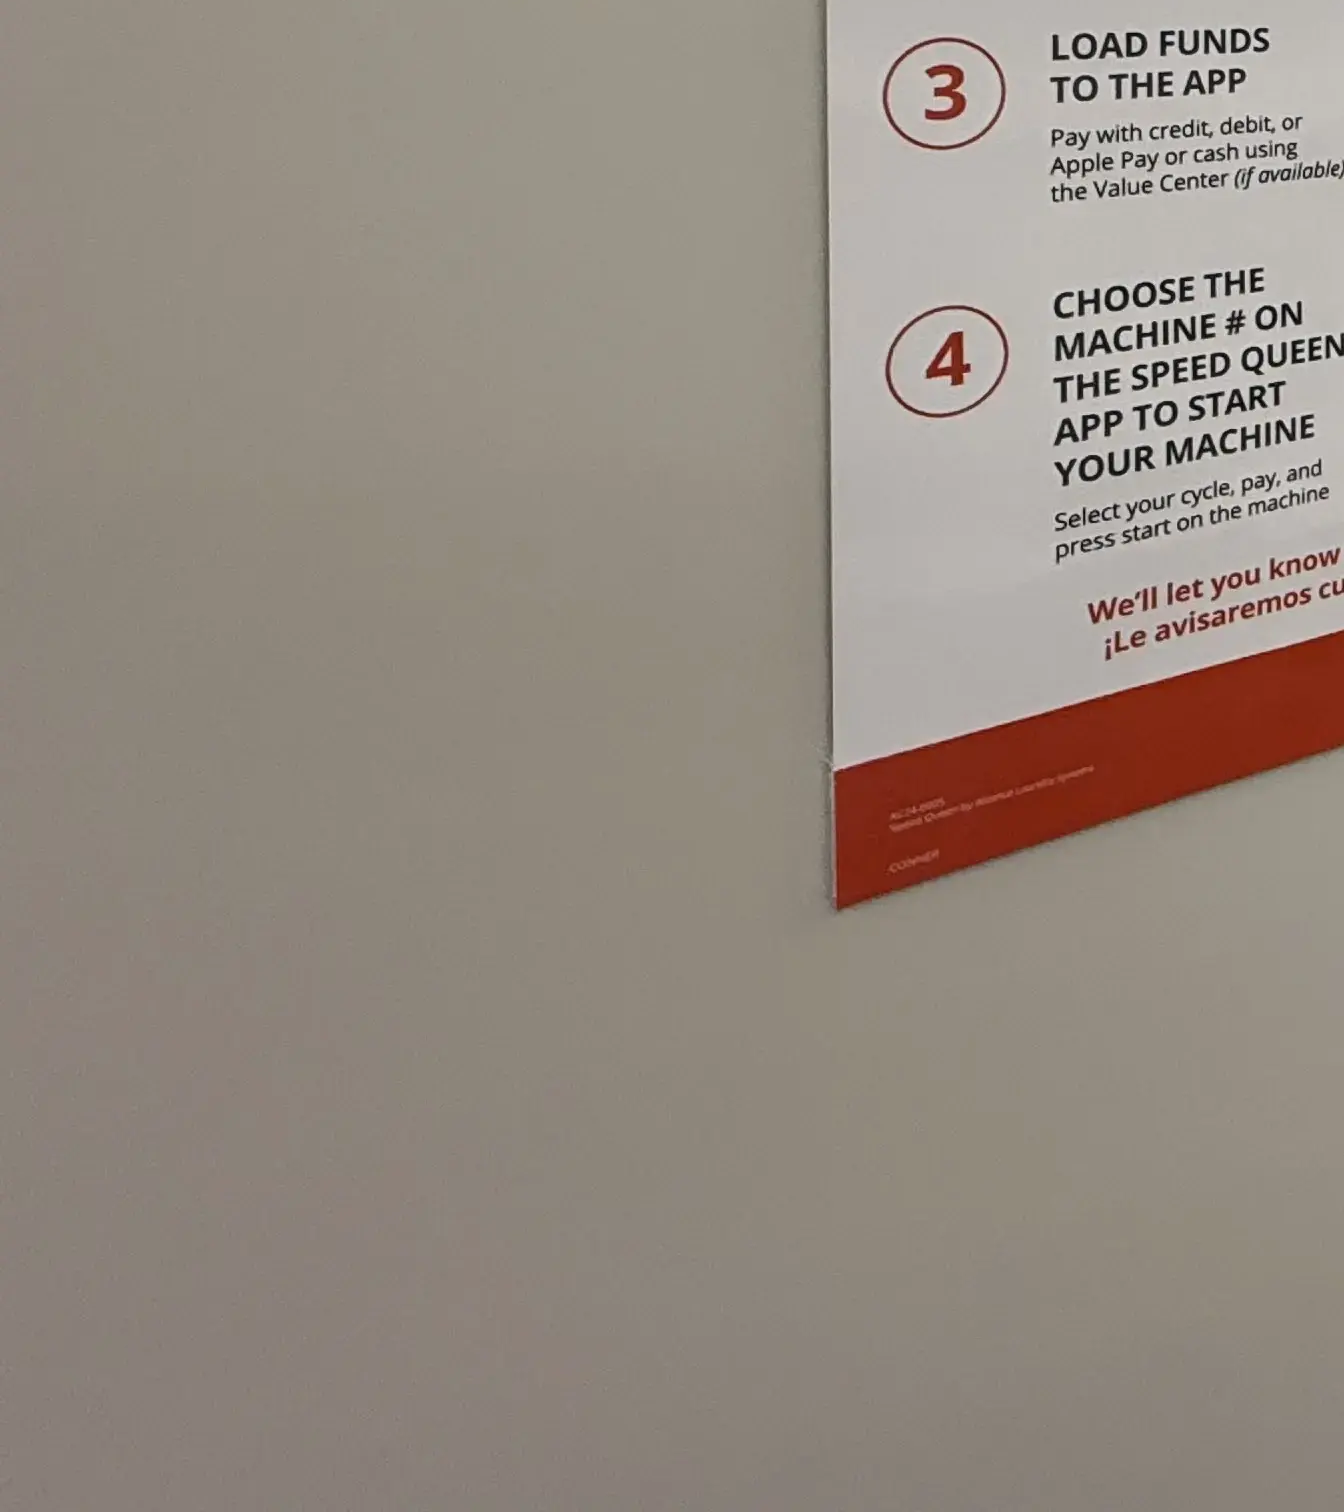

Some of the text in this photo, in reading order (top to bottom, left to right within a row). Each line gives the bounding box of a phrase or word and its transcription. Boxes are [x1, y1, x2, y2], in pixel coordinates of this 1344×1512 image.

[1051, 28, 1270, 61] LOAD FUNDS
[924, 64, 967, 121] 3
[1051, 68, 1246, 104] TO THE APP
[1050, 140, 1298, 178] Apple Pay or cash using
[1051, 114, 1303, 153] Pay with credit, debit, or
[1051, 183, 1087, 202] the
[1094, 176, 1152, 199] Value
[1160, 170, 1229, 193] Center
[1235, 169, 1253, 190] (if
[1053, 268, 1265, 319] CHOOSE THE
[925, 331, 971, 387] 4
[1054, 301, 1302, 362] MACHINE # ON
[1053, 368, 1120, 404] THE
[1131, 351, 1230, 392] SPEED
[1053, 381, 1286, 447] APP TO START
[1054, 414, 1315, 487] YOUR MACHINE
[1055, 459, 1323, 532] Select your cycle, pay, and
[1055, 485, 1330, 564] press start on the machine
[1166, 577, 1204, 608] let
[1211, 563, 1261, 598] you
[1269, 545, 1339, 582] know
[1154, 582, 1311, 642] avisaremos
